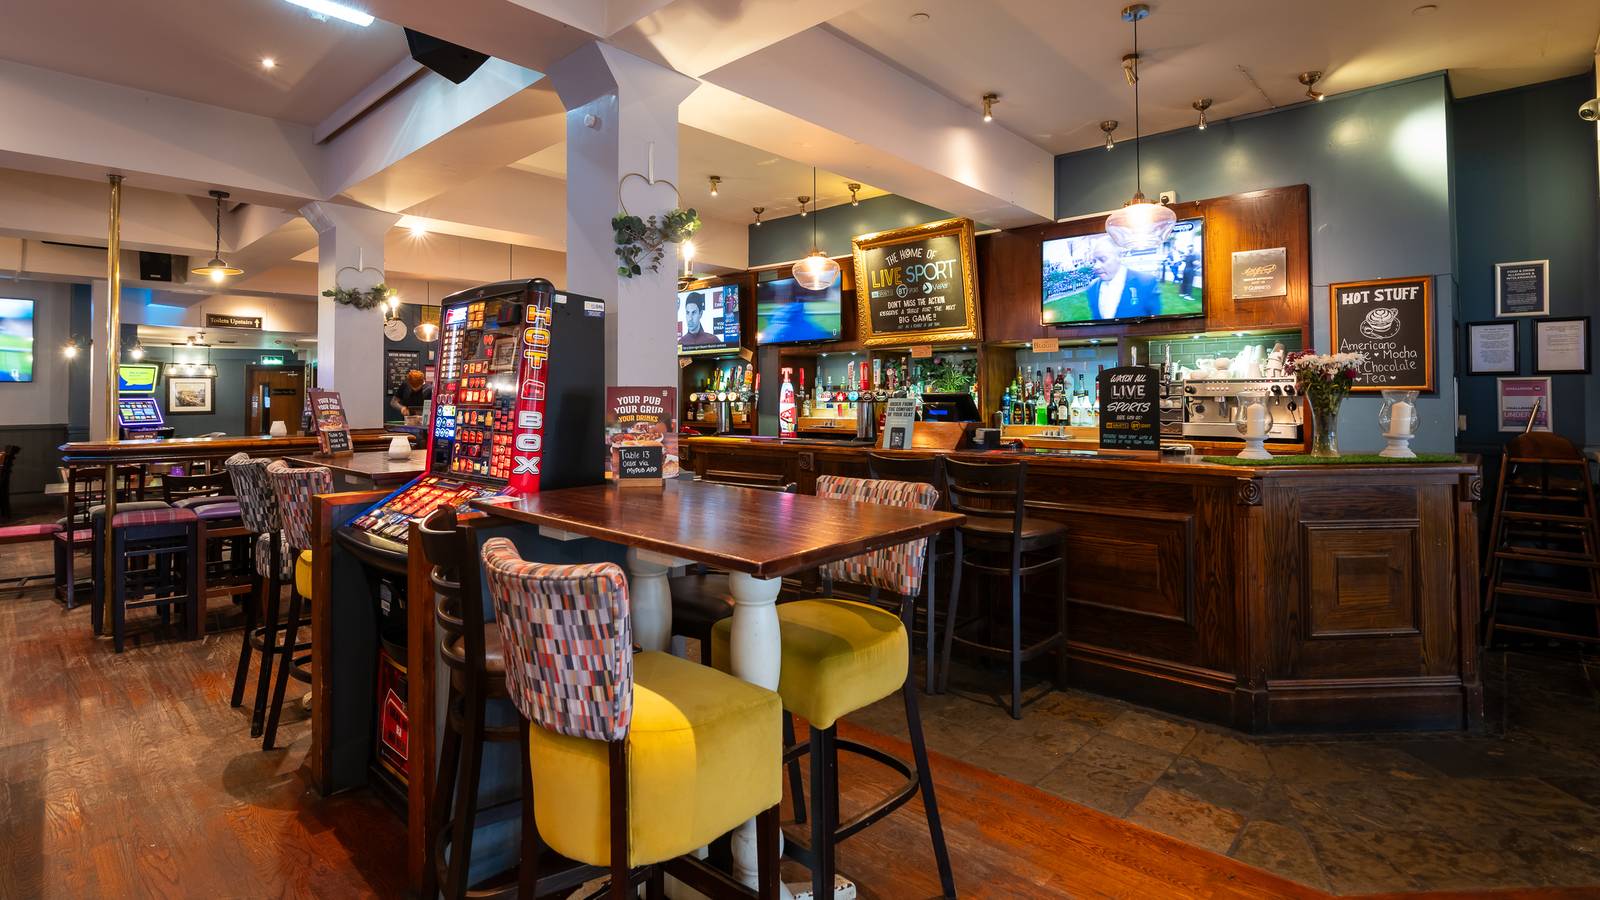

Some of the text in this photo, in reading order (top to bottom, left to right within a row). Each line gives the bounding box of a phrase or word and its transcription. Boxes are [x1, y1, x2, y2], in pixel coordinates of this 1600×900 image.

[885, 248, 937, 266] THE HOME OF
[871, 259, 956, 288] LIVE SPORT
[928, 296, 945, 304] ACTION
[1342, 287, 1419, 305] HOT STUFF
[1340, 338, 1396, 350] Americano
[1383, 345, 1417, 359] Mocha
[1364, 359, 1416, 372] Chocolate
[1362, 373, 1386, 383] Tea
[512, 304, 552, 474] HOT BOX
[1112, 385, 1146, 398] LIVE
[617, 396, 661, 405] YOUR PUB
[614, 405, 637, 414] YOUR
[1107, 402, 1151, 412] SPORTS
[619, 449, 639, 460] Table
